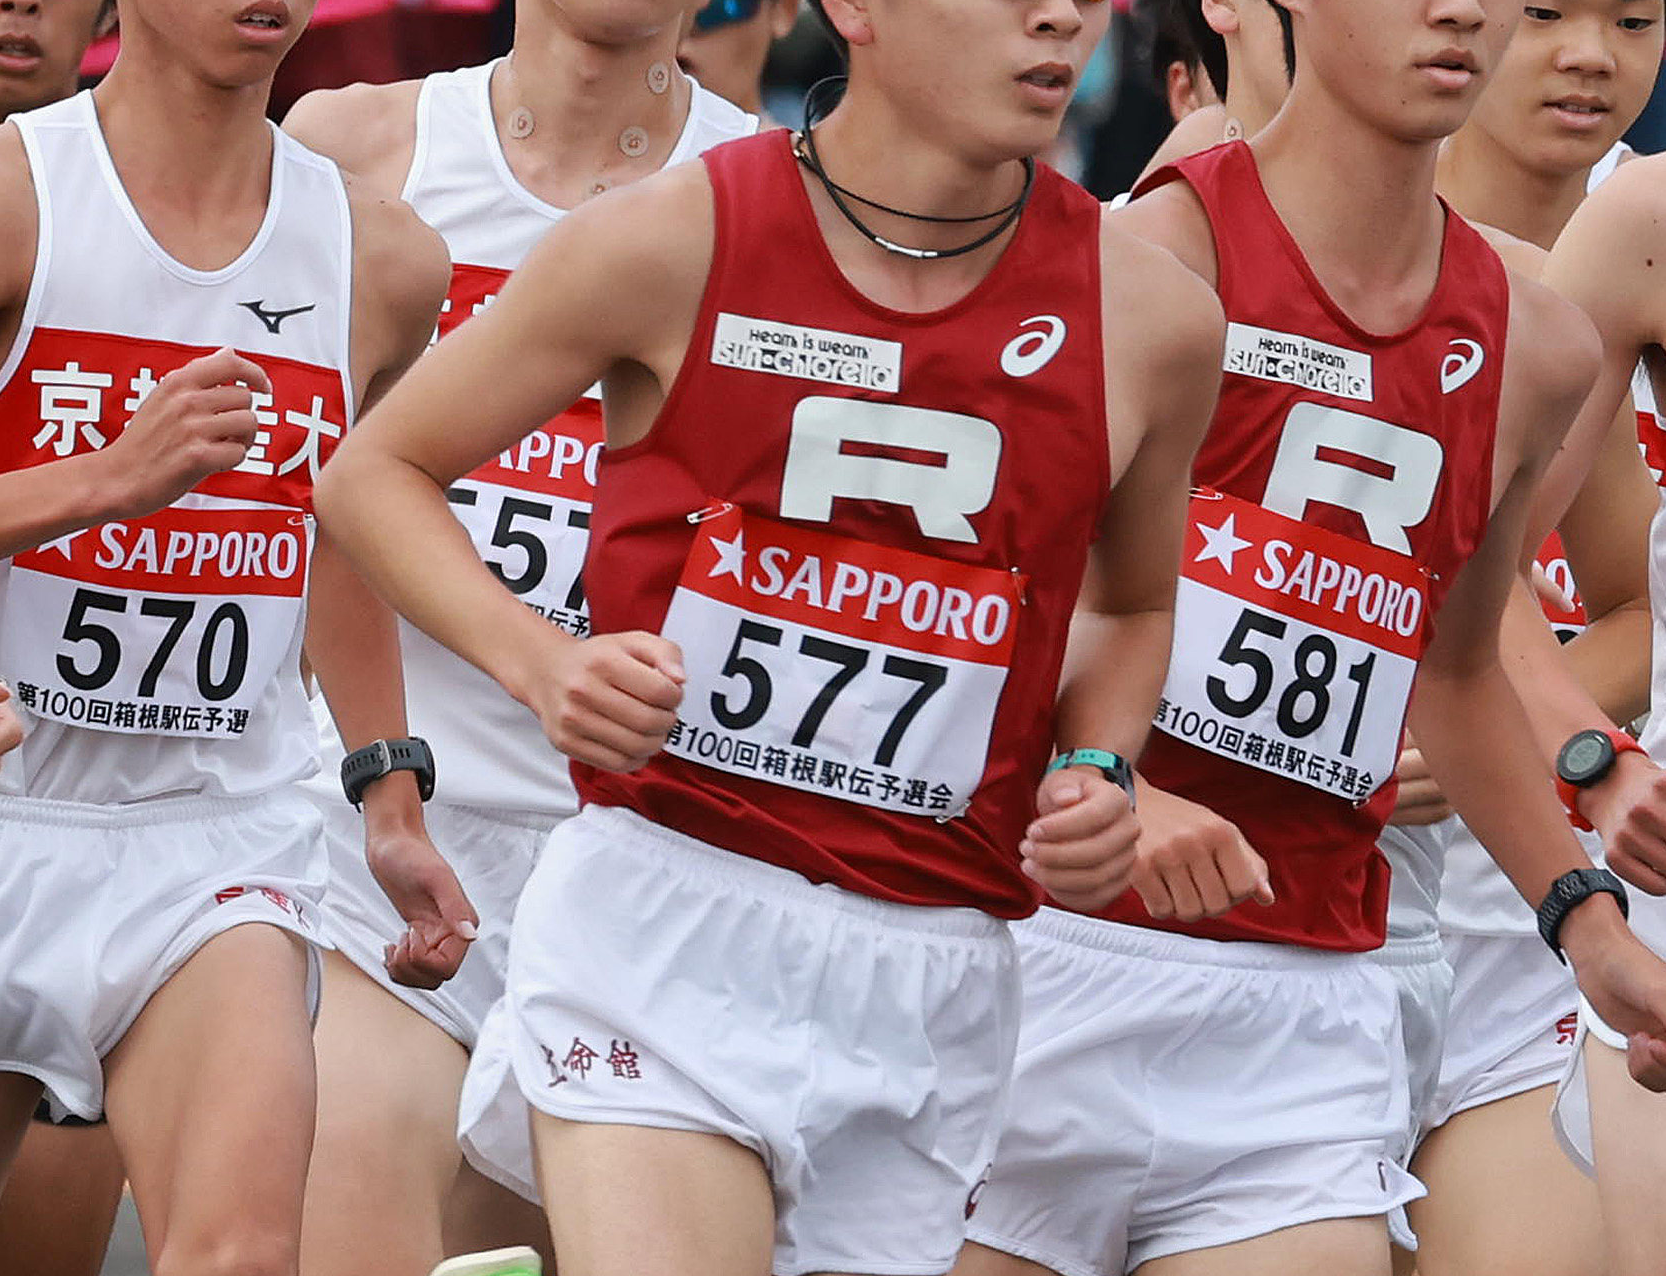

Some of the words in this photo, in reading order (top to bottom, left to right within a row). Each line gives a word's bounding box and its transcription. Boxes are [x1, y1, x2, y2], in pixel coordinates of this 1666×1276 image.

[780, 395, 1002, 544] R
[1261, 400, 1444, 556] R
[94, 522, 298, 579] SAPPORO
[751, 546, 1010, 646] SAPPORO
[1254, 539, 1423, 638] SAPPORO
[56, 587, 249, 702] 570
[710, 618, 949, 769] 577
[1206, 608, 1378, 759] 581
